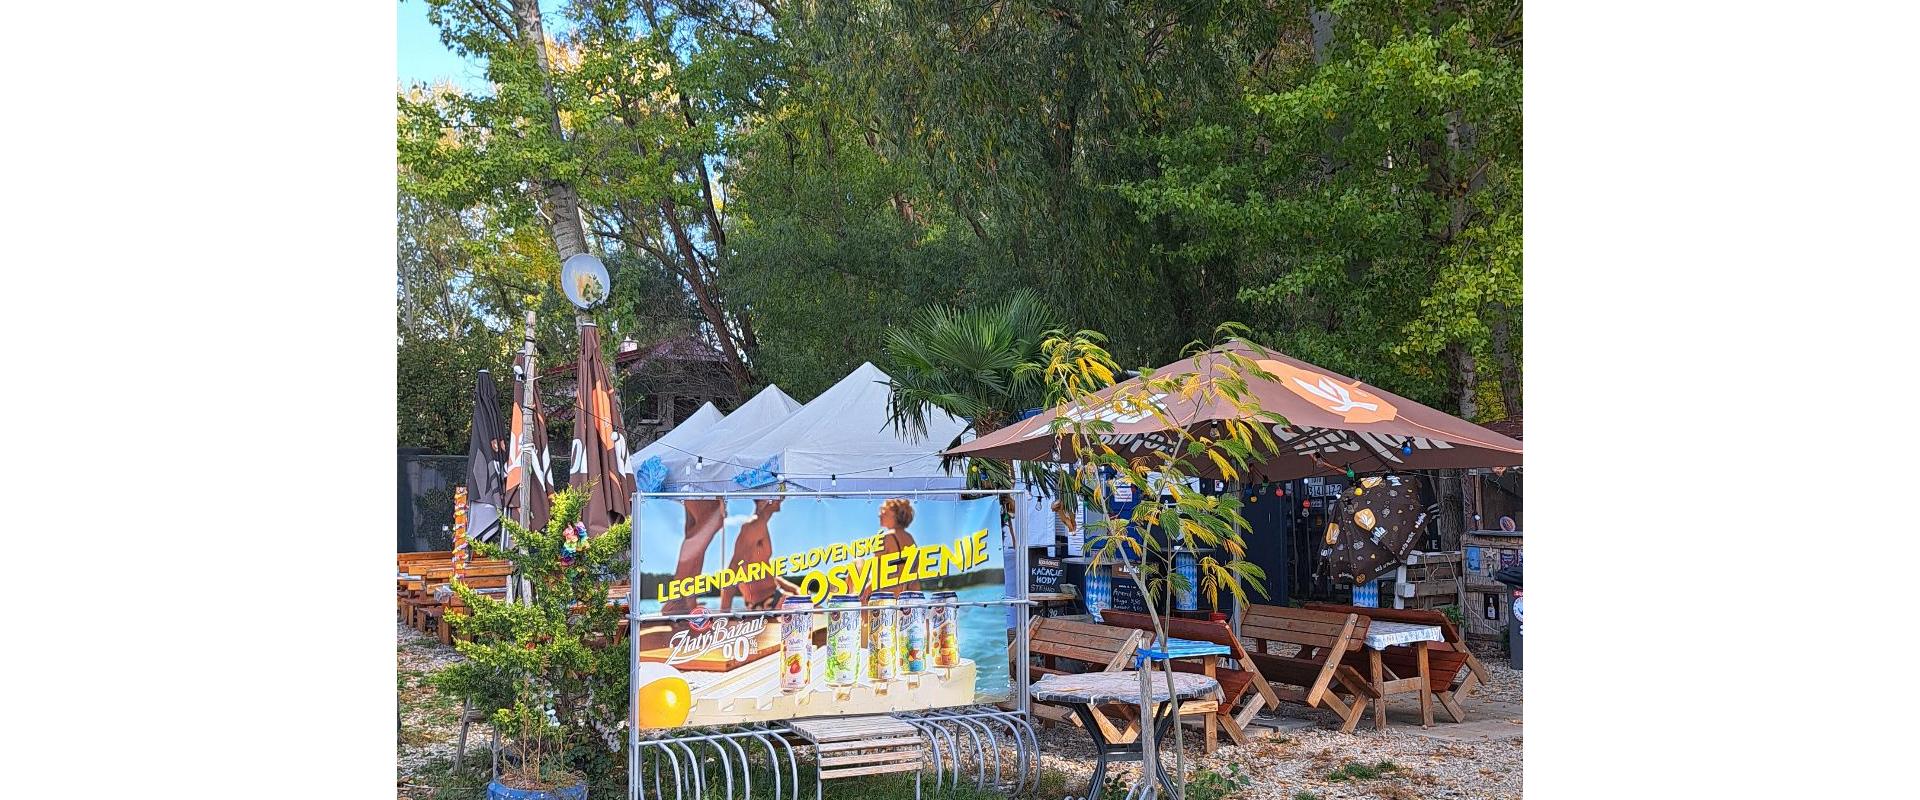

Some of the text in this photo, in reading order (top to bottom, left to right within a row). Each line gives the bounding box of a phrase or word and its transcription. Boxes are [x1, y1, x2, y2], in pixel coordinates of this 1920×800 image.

[657, 529, 887, 603] LEGENDÁRNE SLOVENSKÉ
[799, 529, 990, 606] OSVIEŽENIE
[664, 628, 713, 666] Zlatý
